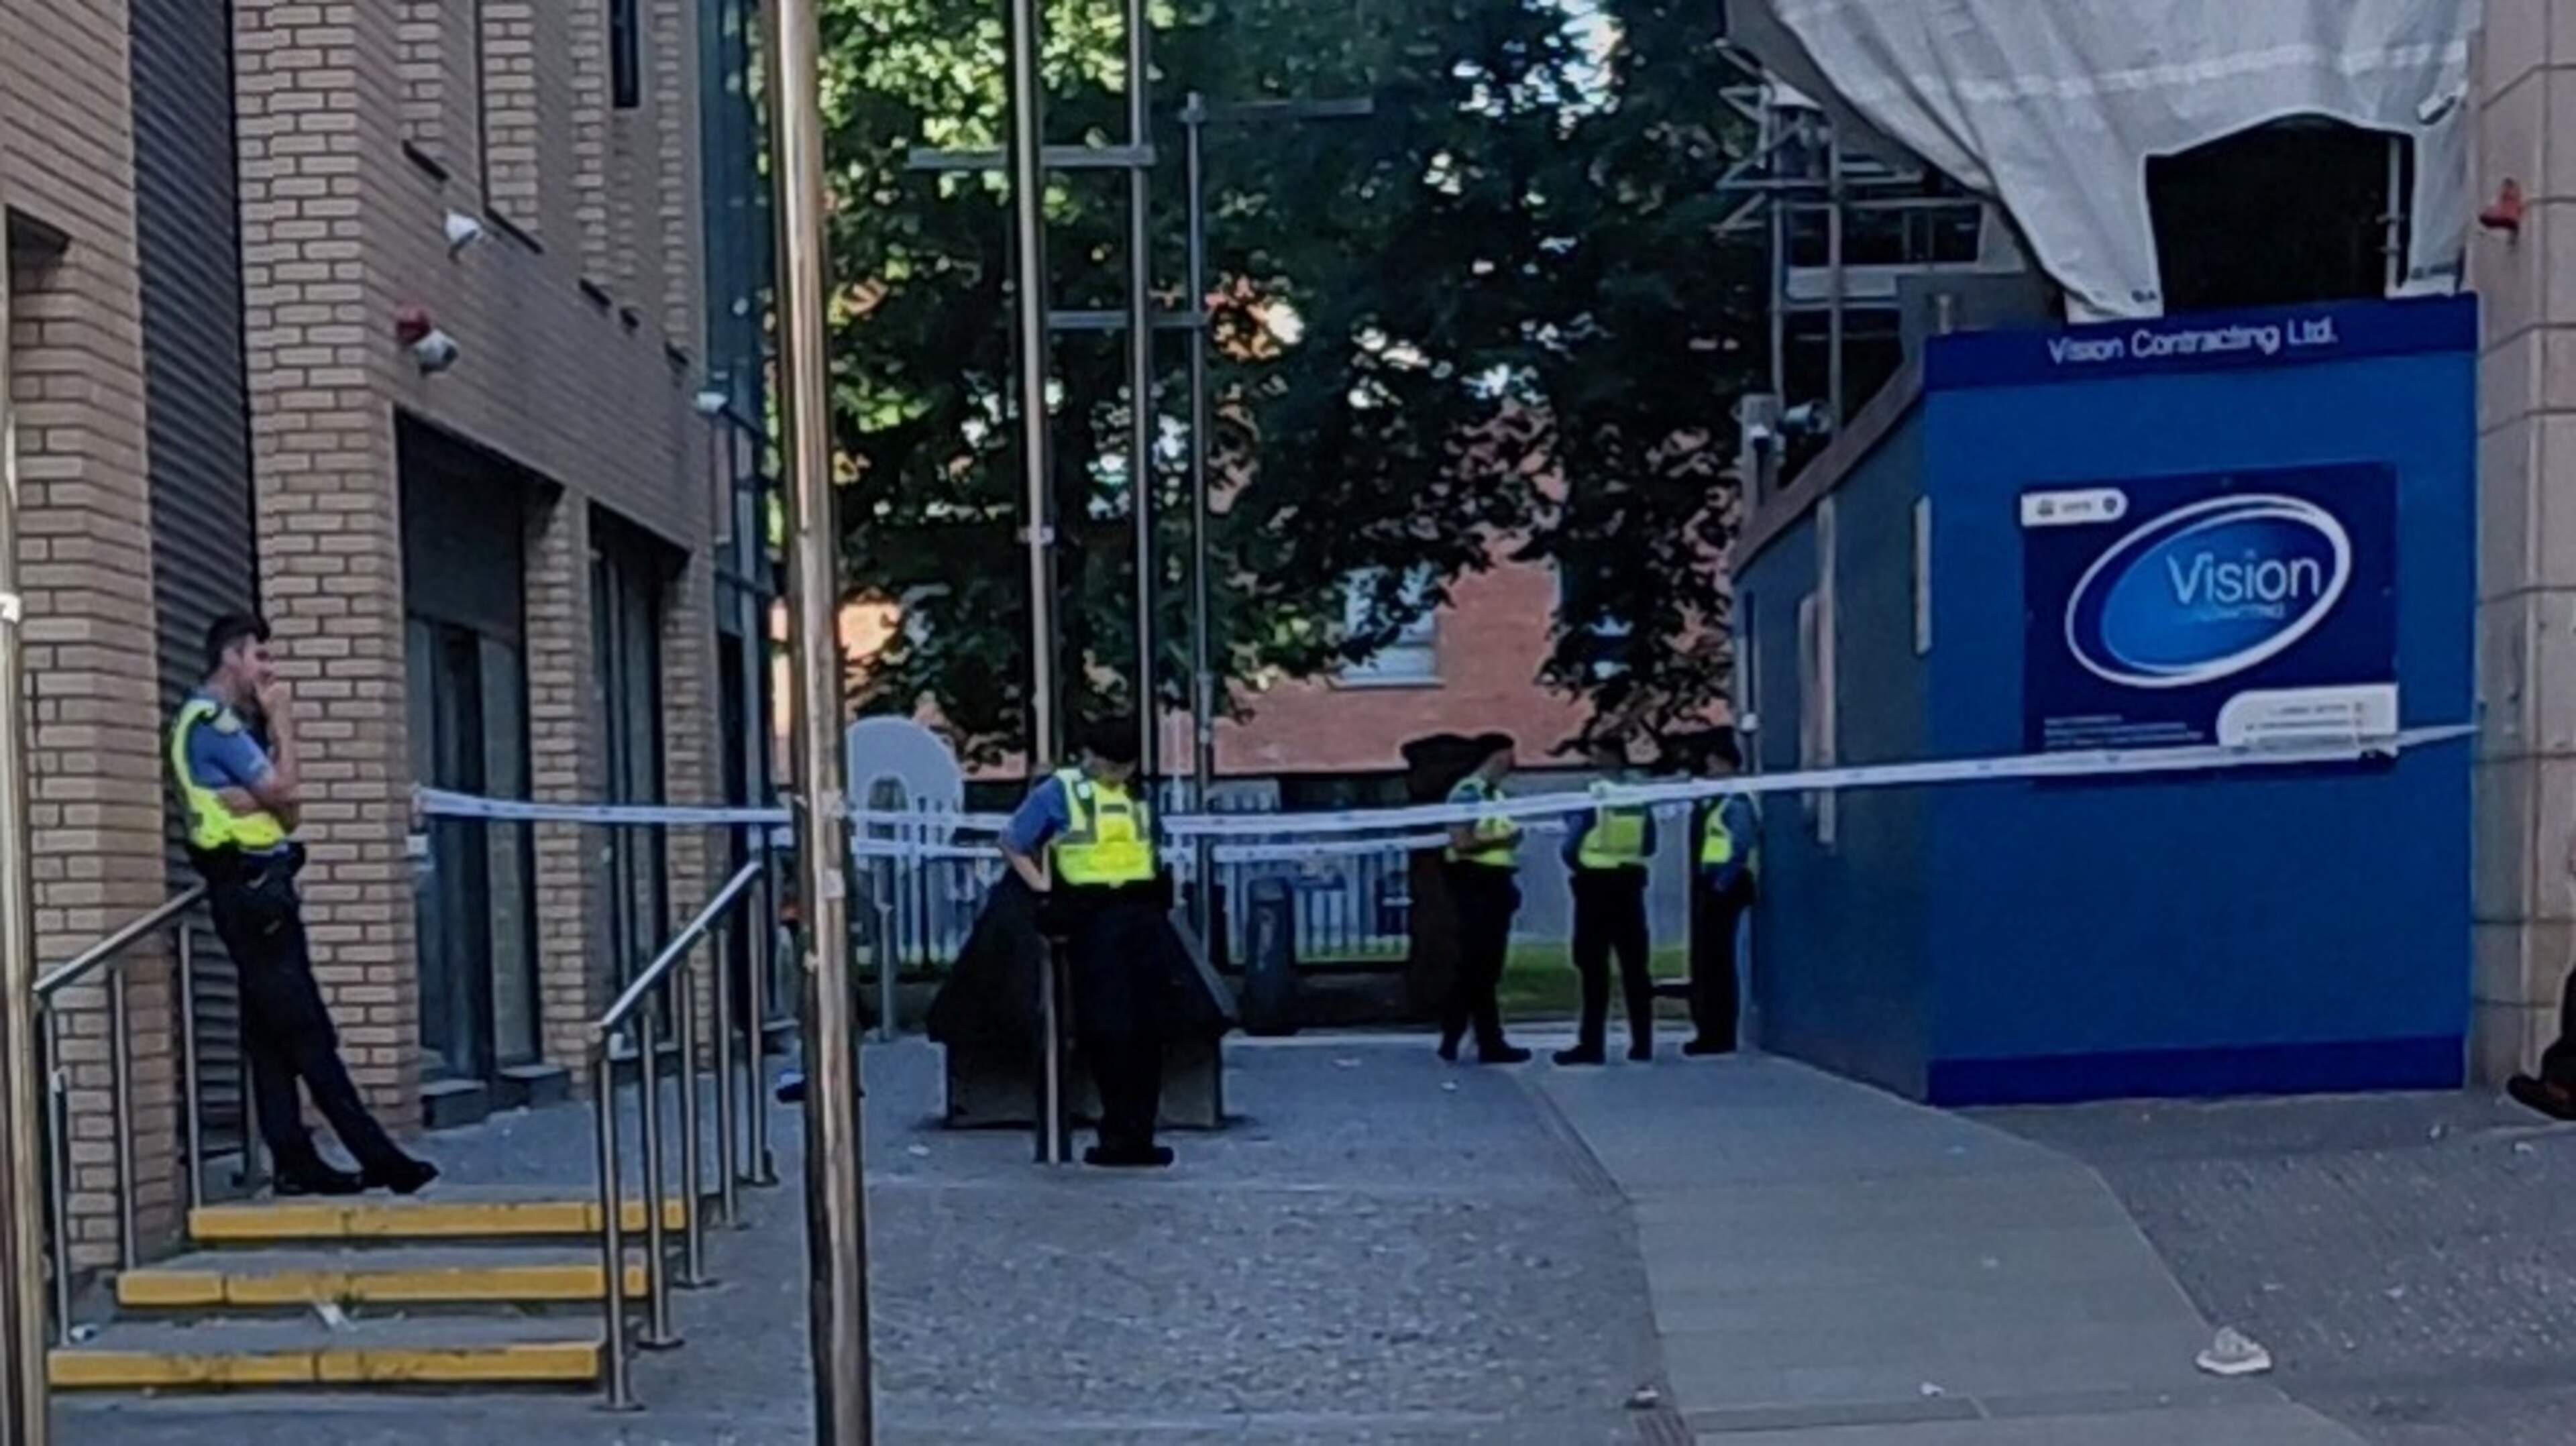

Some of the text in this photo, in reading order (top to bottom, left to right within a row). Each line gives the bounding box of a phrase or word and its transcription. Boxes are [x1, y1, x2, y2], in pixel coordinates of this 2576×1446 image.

[2047, 337, 2124, 364] Vision
[2132, 325, 2280, 357] Contracting
[2166, 549, 2320, 604] Vision
